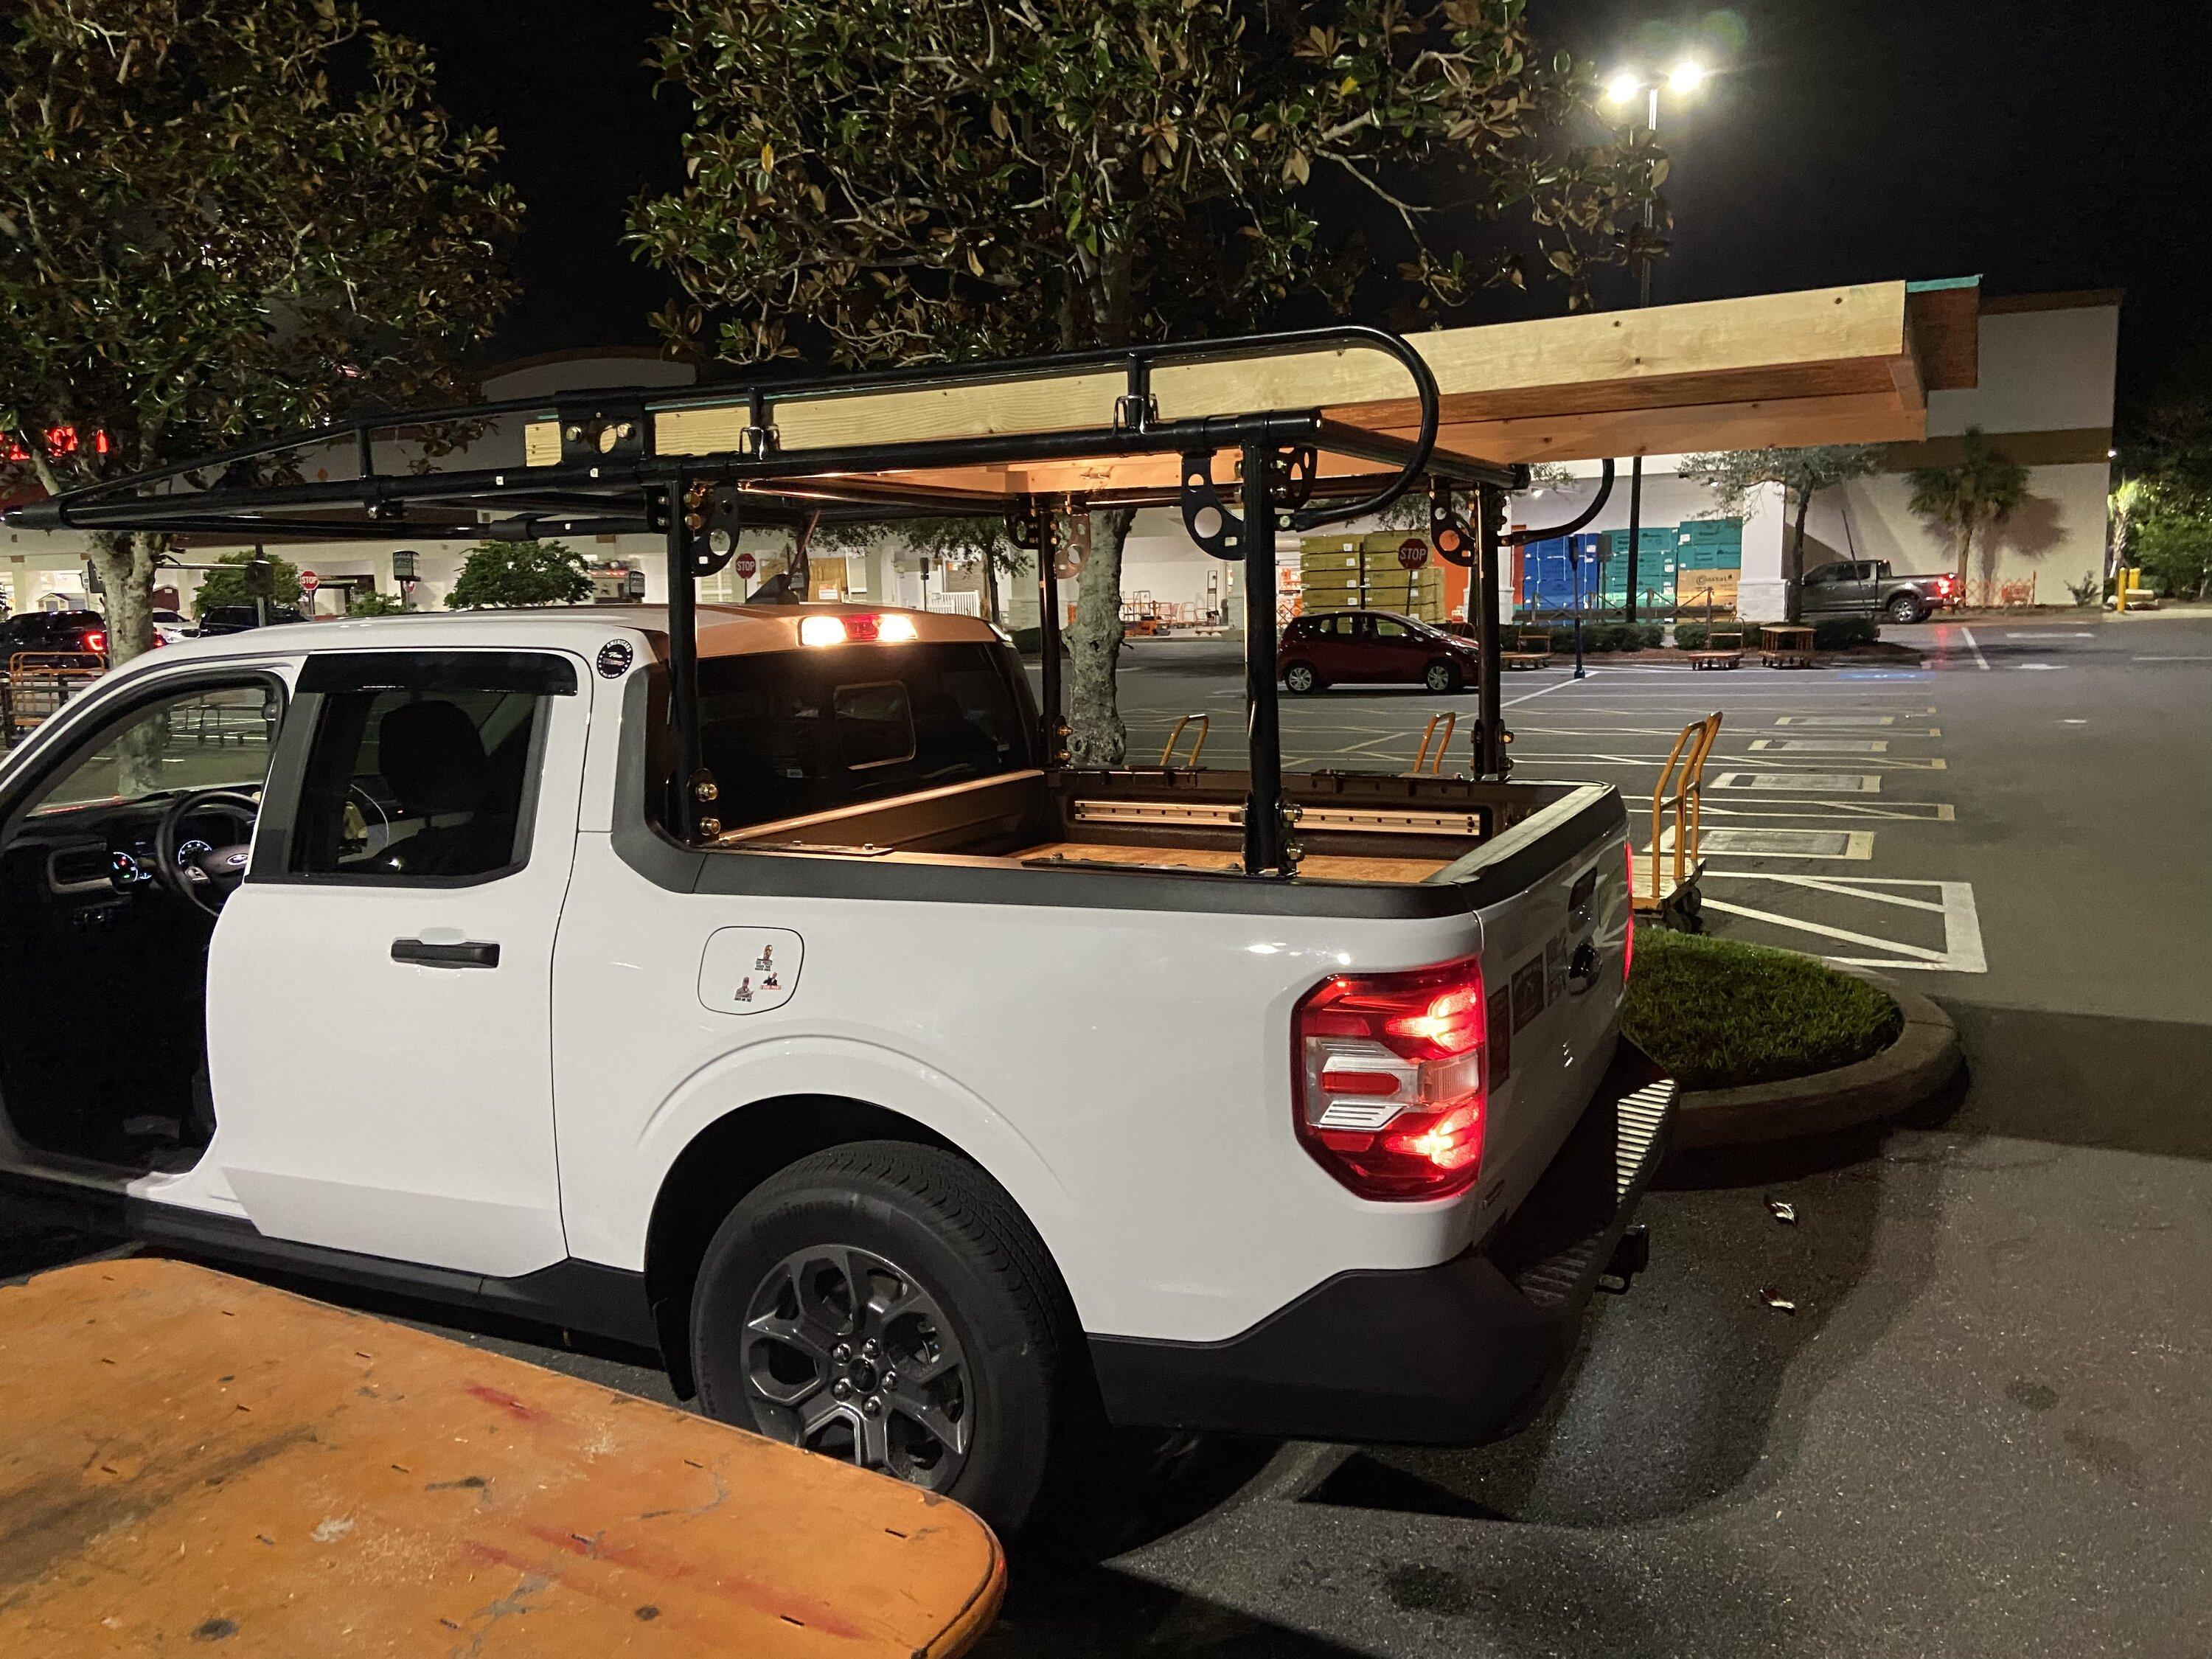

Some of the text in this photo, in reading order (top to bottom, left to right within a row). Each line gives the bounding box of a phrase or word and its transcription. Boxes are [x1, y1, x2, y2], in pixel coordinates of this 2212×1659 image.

[1399, 548, 1427, 561] STOP
[736, 561, 755, 571] STOP
[302, 576, 318, 585] STOP
